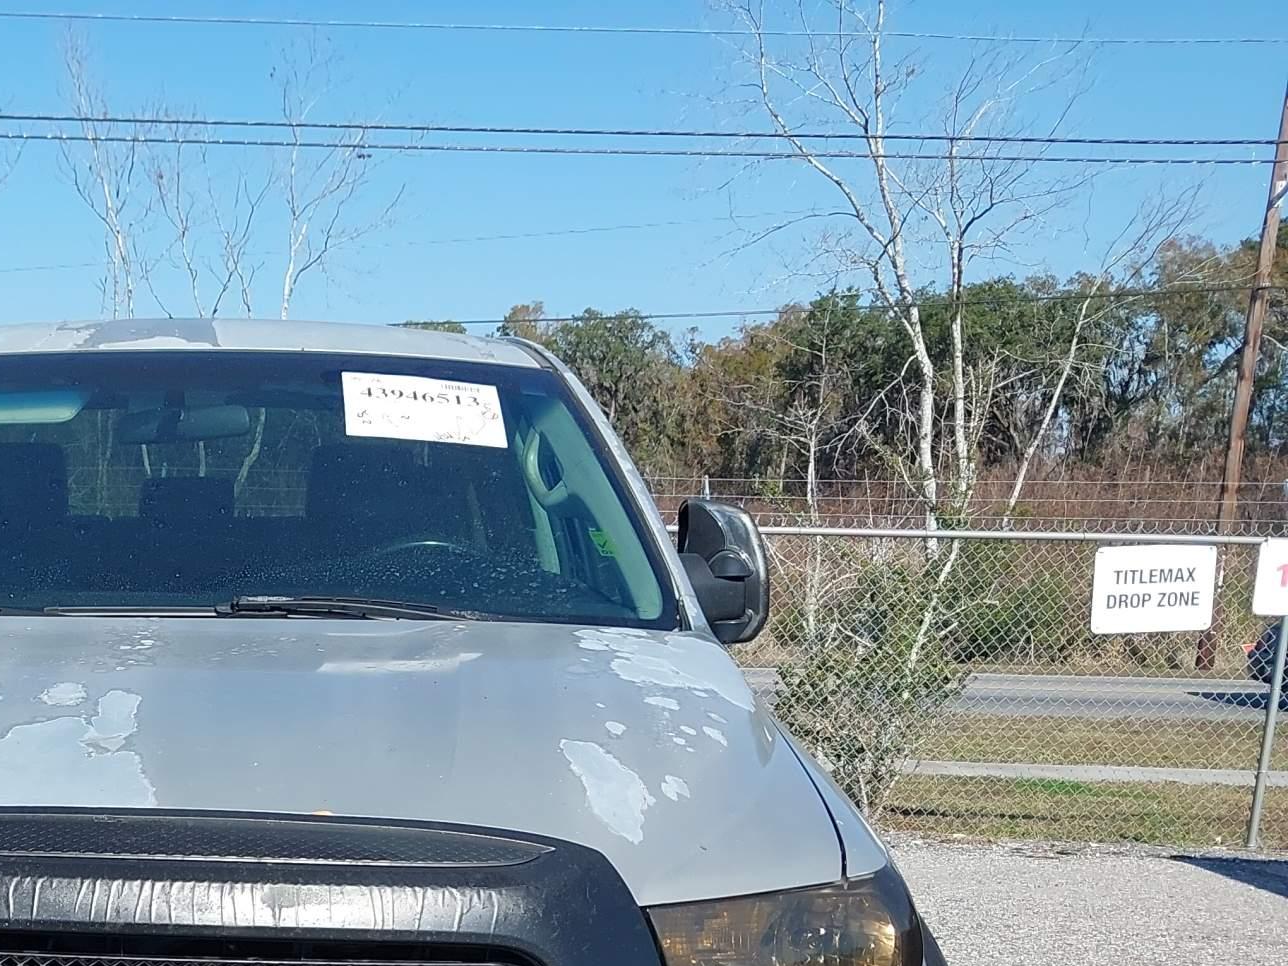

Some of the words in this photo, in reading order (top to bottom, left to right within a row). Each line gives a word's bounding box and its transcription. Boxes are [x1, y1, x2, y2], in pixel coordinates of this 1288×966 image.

[359, 386, 480, 407] 43946513
[1113, 567, 1197, 585] TITLEMAX
[1106, 593, 1152, 609] DROP
[1156, 591, 1201, 608] ZONE
